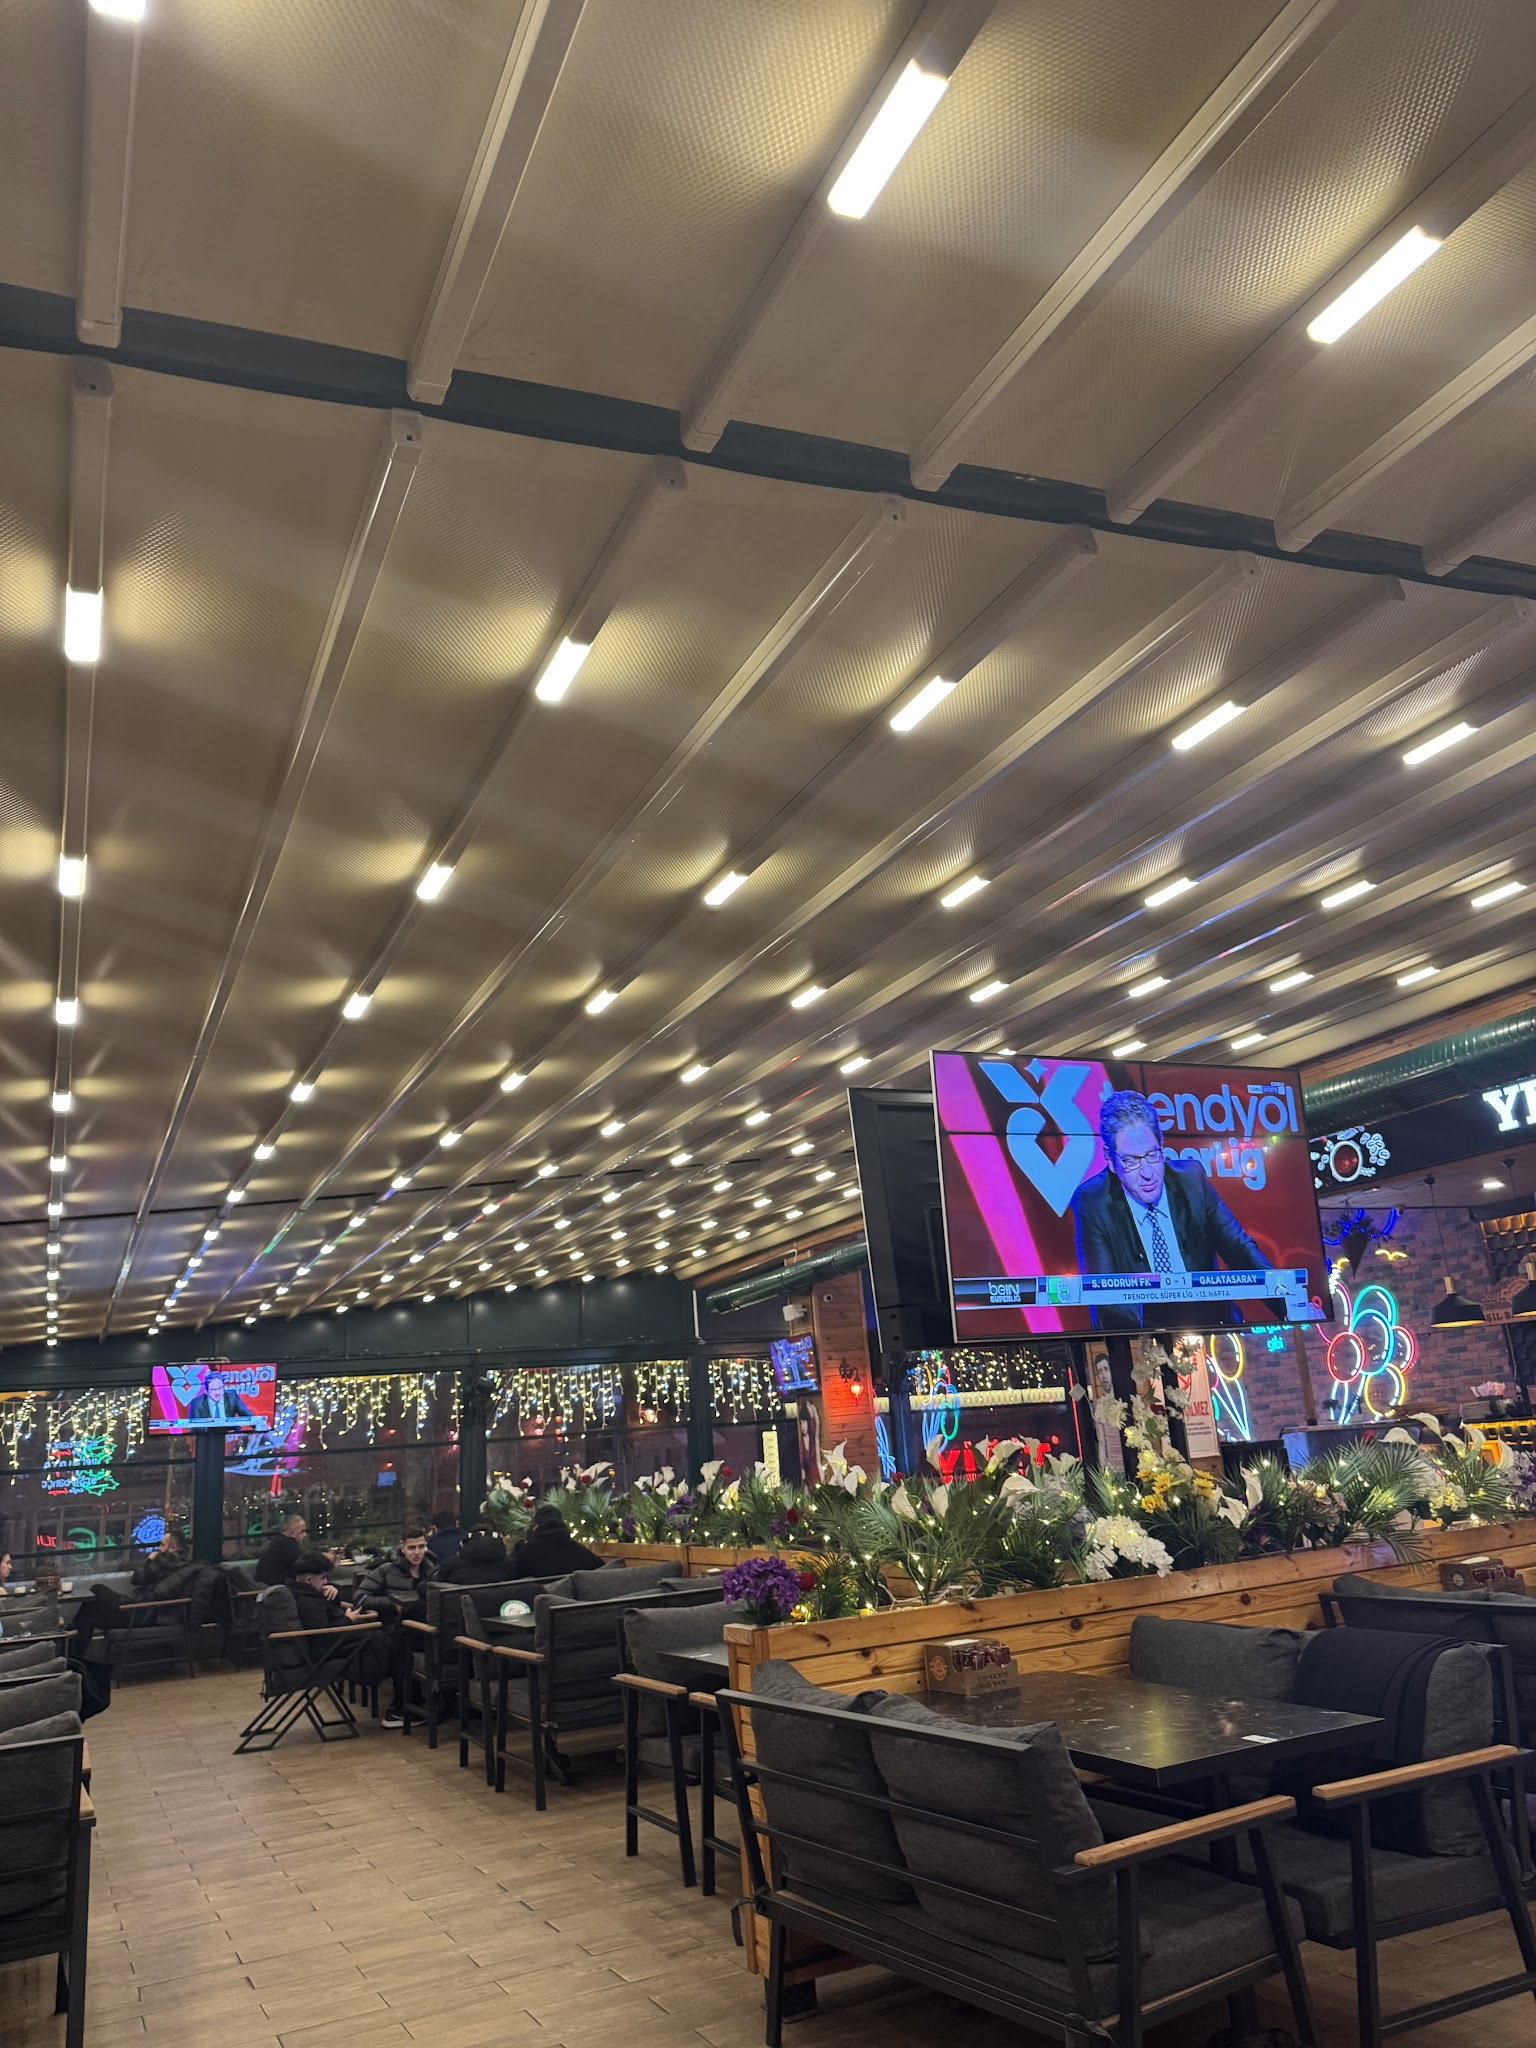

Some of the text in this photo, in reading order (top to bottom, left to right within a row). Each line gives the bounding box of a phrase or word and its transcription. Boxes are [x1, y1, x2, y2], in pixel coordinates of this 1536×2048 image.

[1102, 1276, 1138, 1288] BODRUM
[1139, 1277, 1152, 1287] FK
[1165, 1277, 1172, 1286] 0
[1199, 1274, 1257, 1285] GALATASARAY
[1123, 1292, 1159, 1301] TRENDYOL
[1160, 1290, 1181, 1299] SÜPER
[1208, 1290, 1230, 1298] HAFTA
